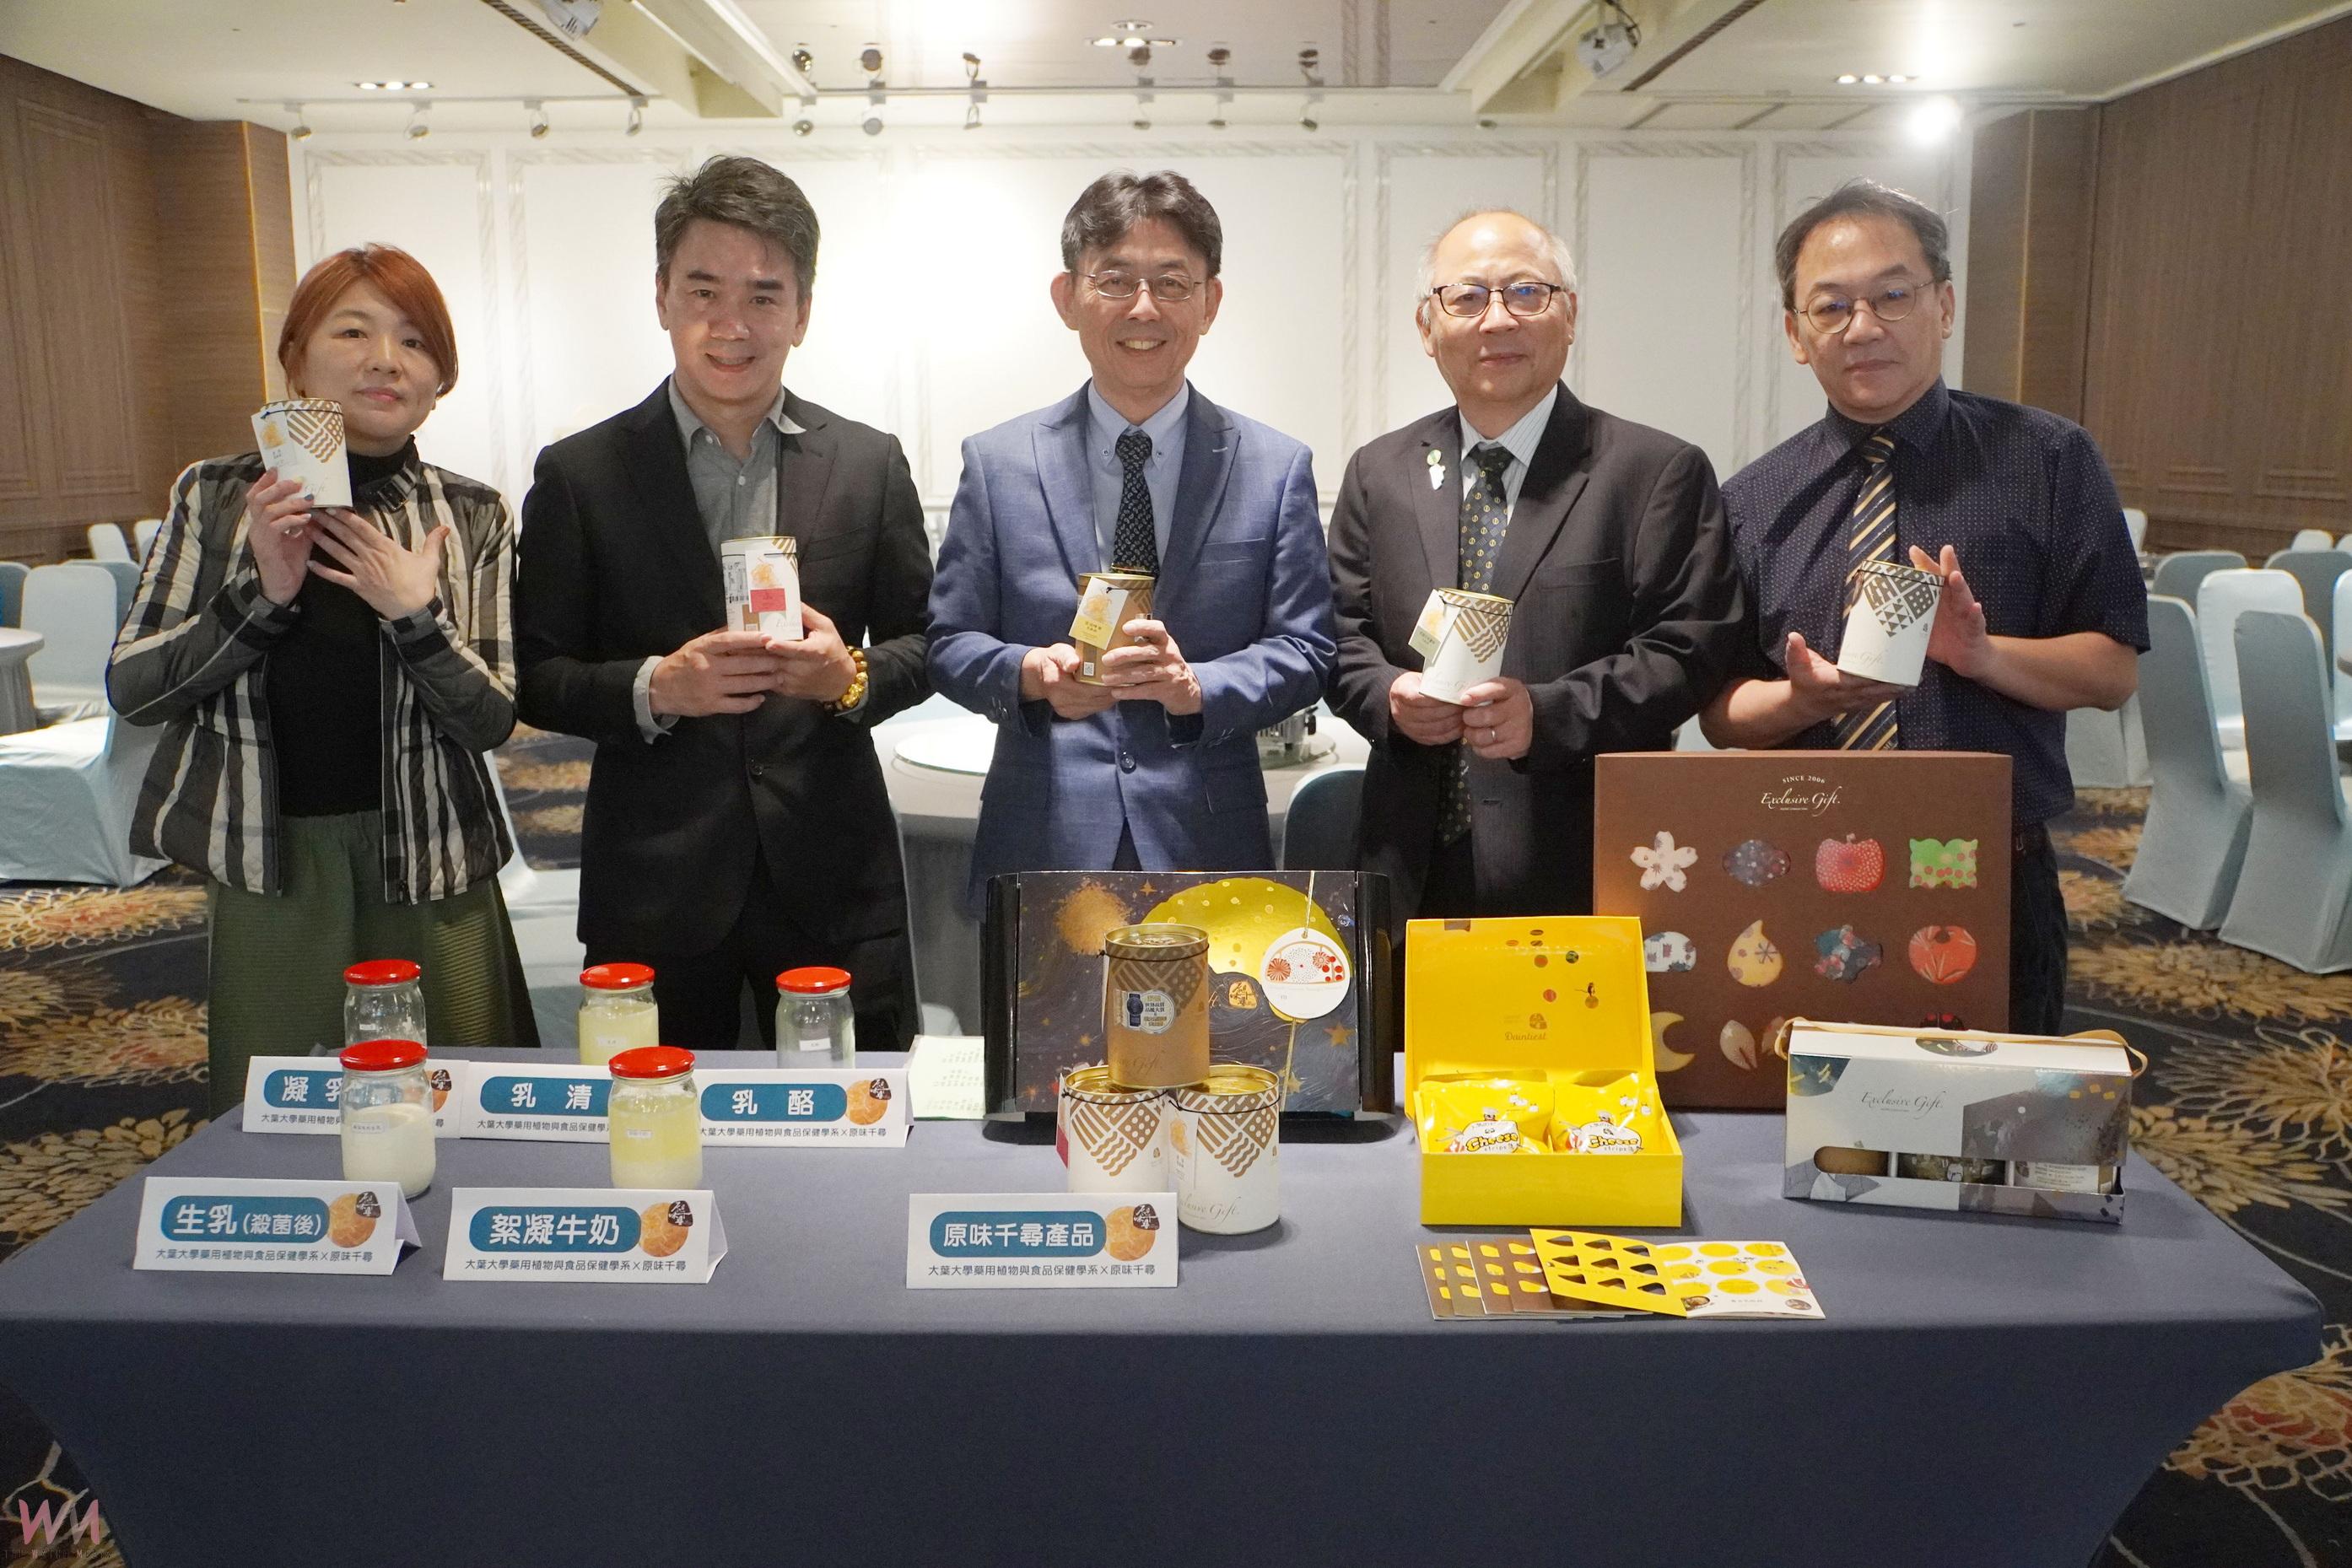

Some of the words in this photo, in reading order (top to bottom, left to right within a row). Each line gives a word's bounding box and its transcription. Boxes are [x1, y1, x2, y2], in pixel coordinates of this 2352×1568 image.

[1783, 775, 1804, 784] SINCE
[1808, 775, 1826, 784] 2006
[1761, 788, 1809, 810] Exclusive
[1861, 1089, 1910, 1108] Exclusive
[1465, 1133, 1519, 1152] Cheese
[489, 1213, 620, 1245] 絮凝牛奶
[943, 1222, 1094, 1247] 原味千尋產品
